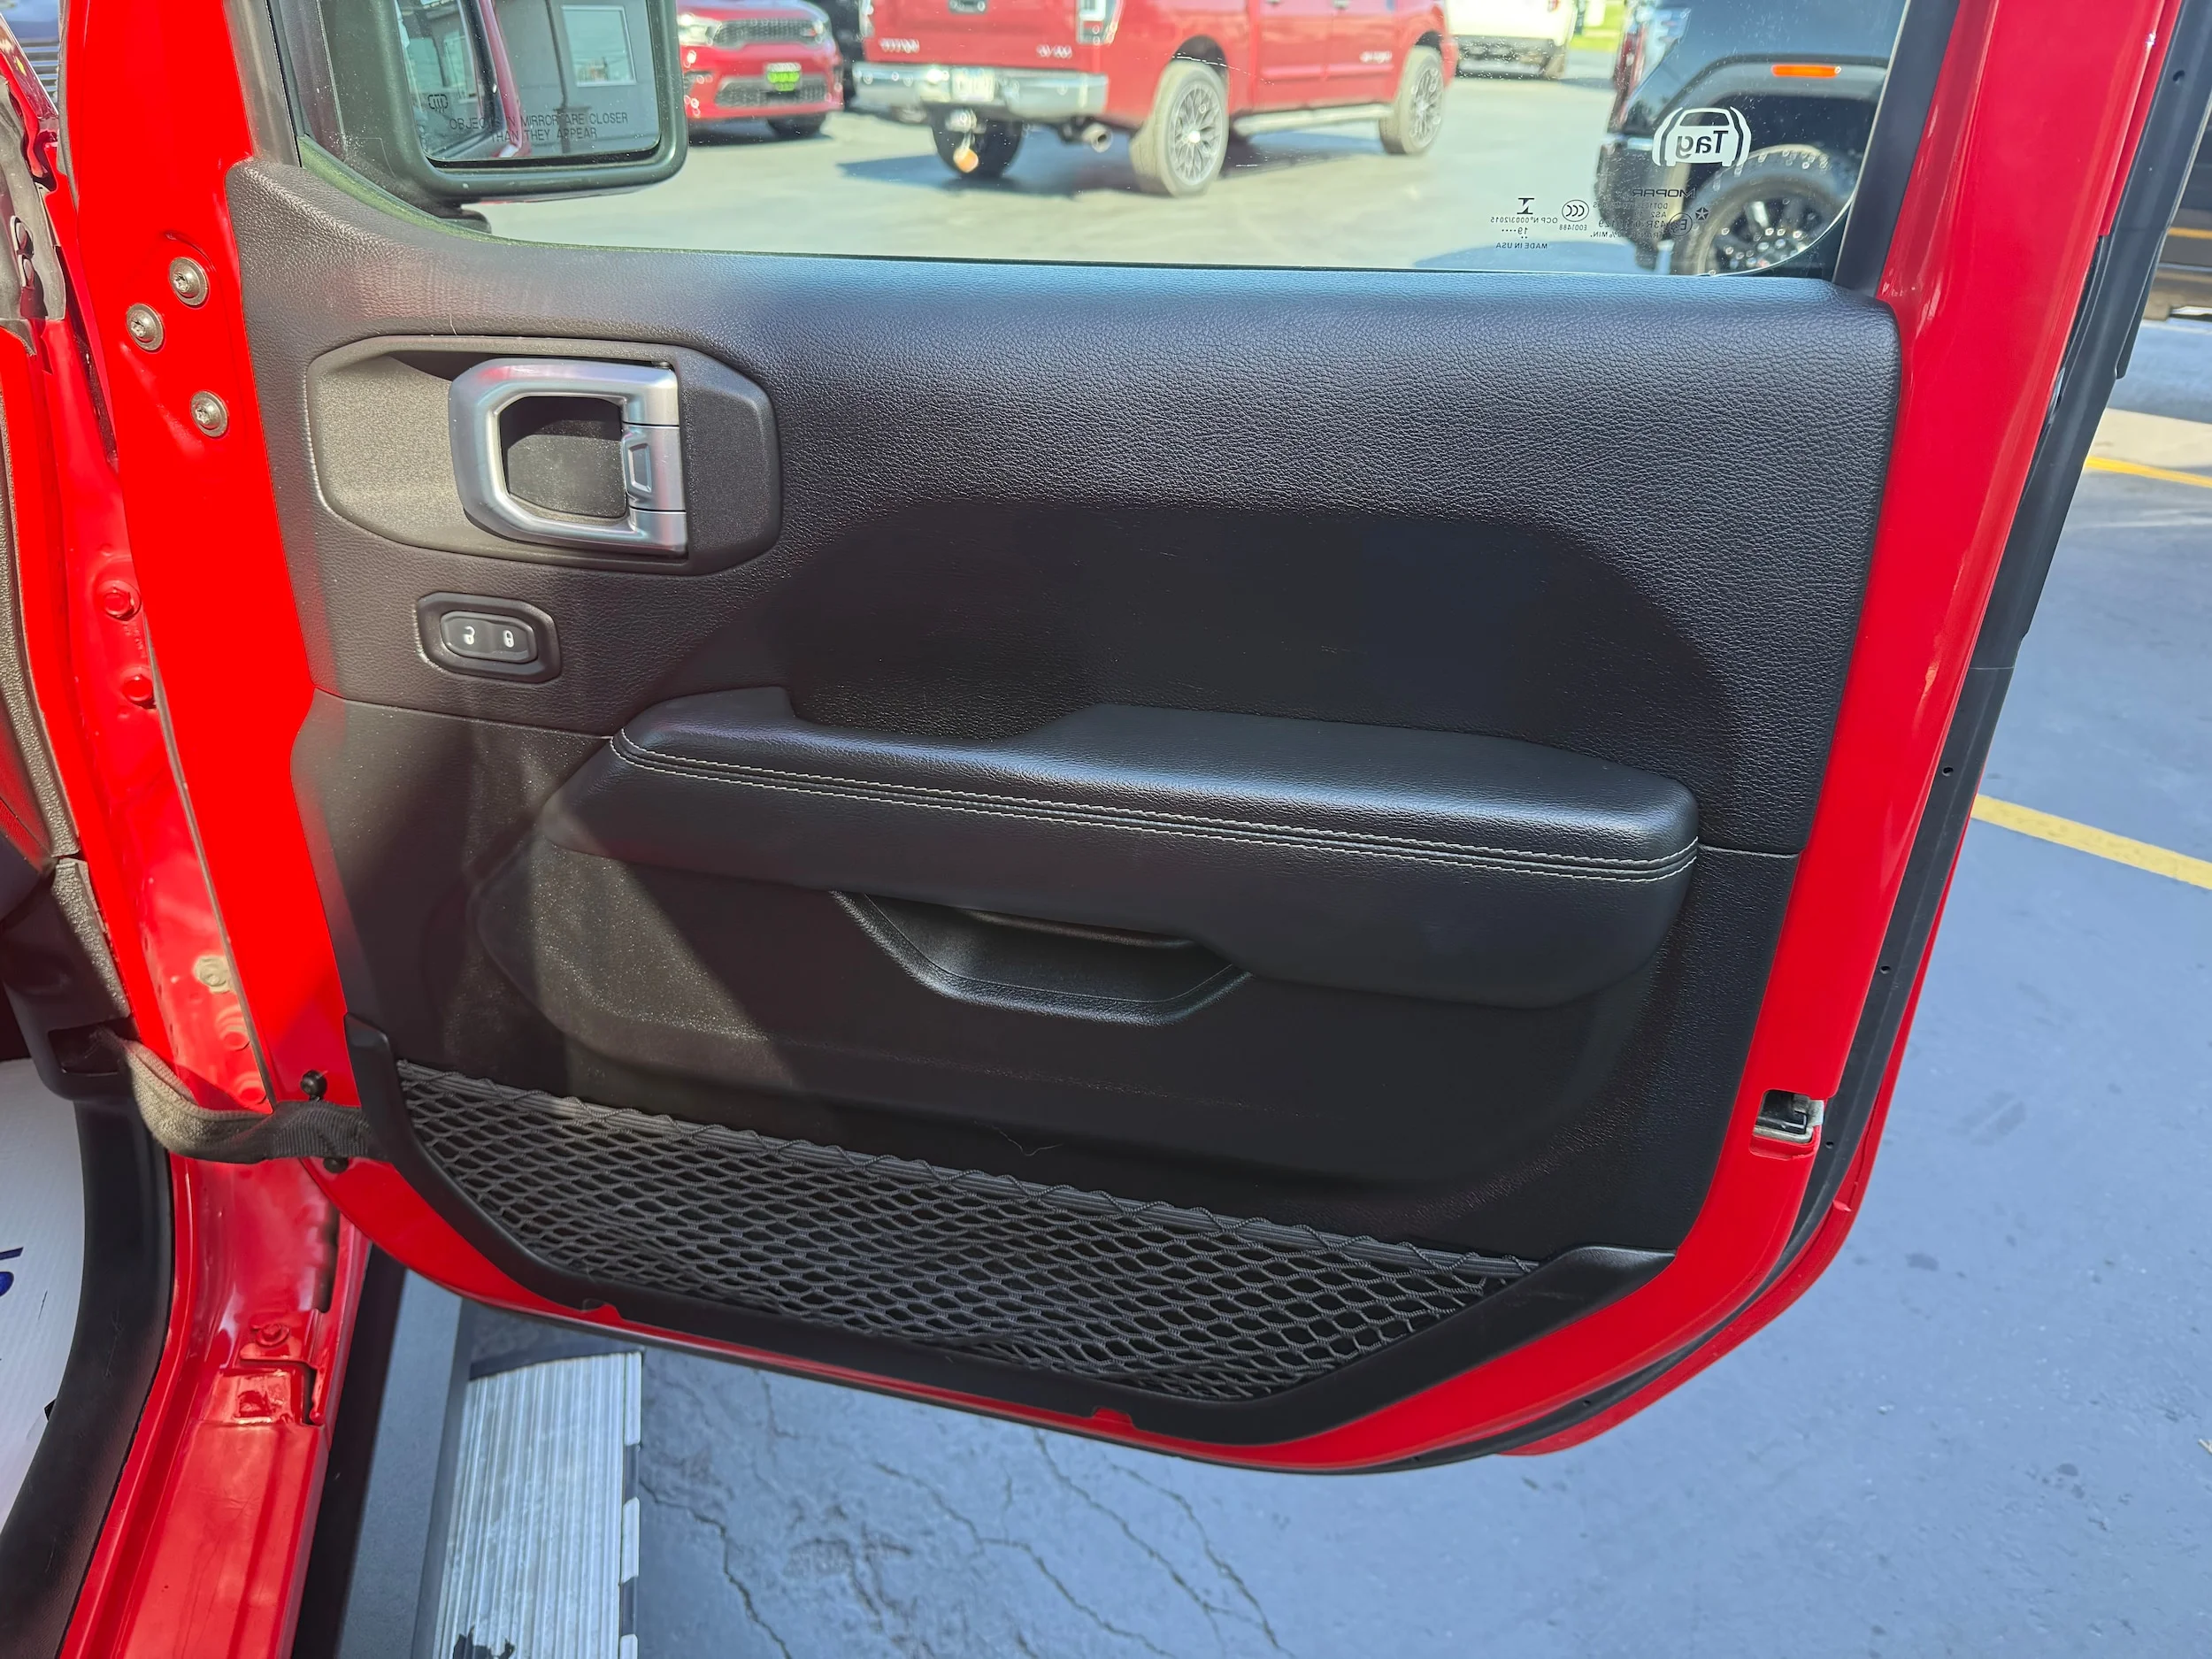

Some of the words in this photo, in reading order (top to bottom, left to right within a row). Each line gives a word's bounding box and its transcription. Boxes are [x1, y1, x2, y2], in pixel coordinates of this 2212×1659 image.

[449, 115, 502, 130] OBJECTS
[520, 112, 559, 127] MIRROR
[565, 111, 585, 125] ARE
[589, 111, 629, 124] CLOSER
[491, 130, 519, 143] THAN
[524, 129, 550, 142] THEY
[557, 127, 598, 141] APPEAR
